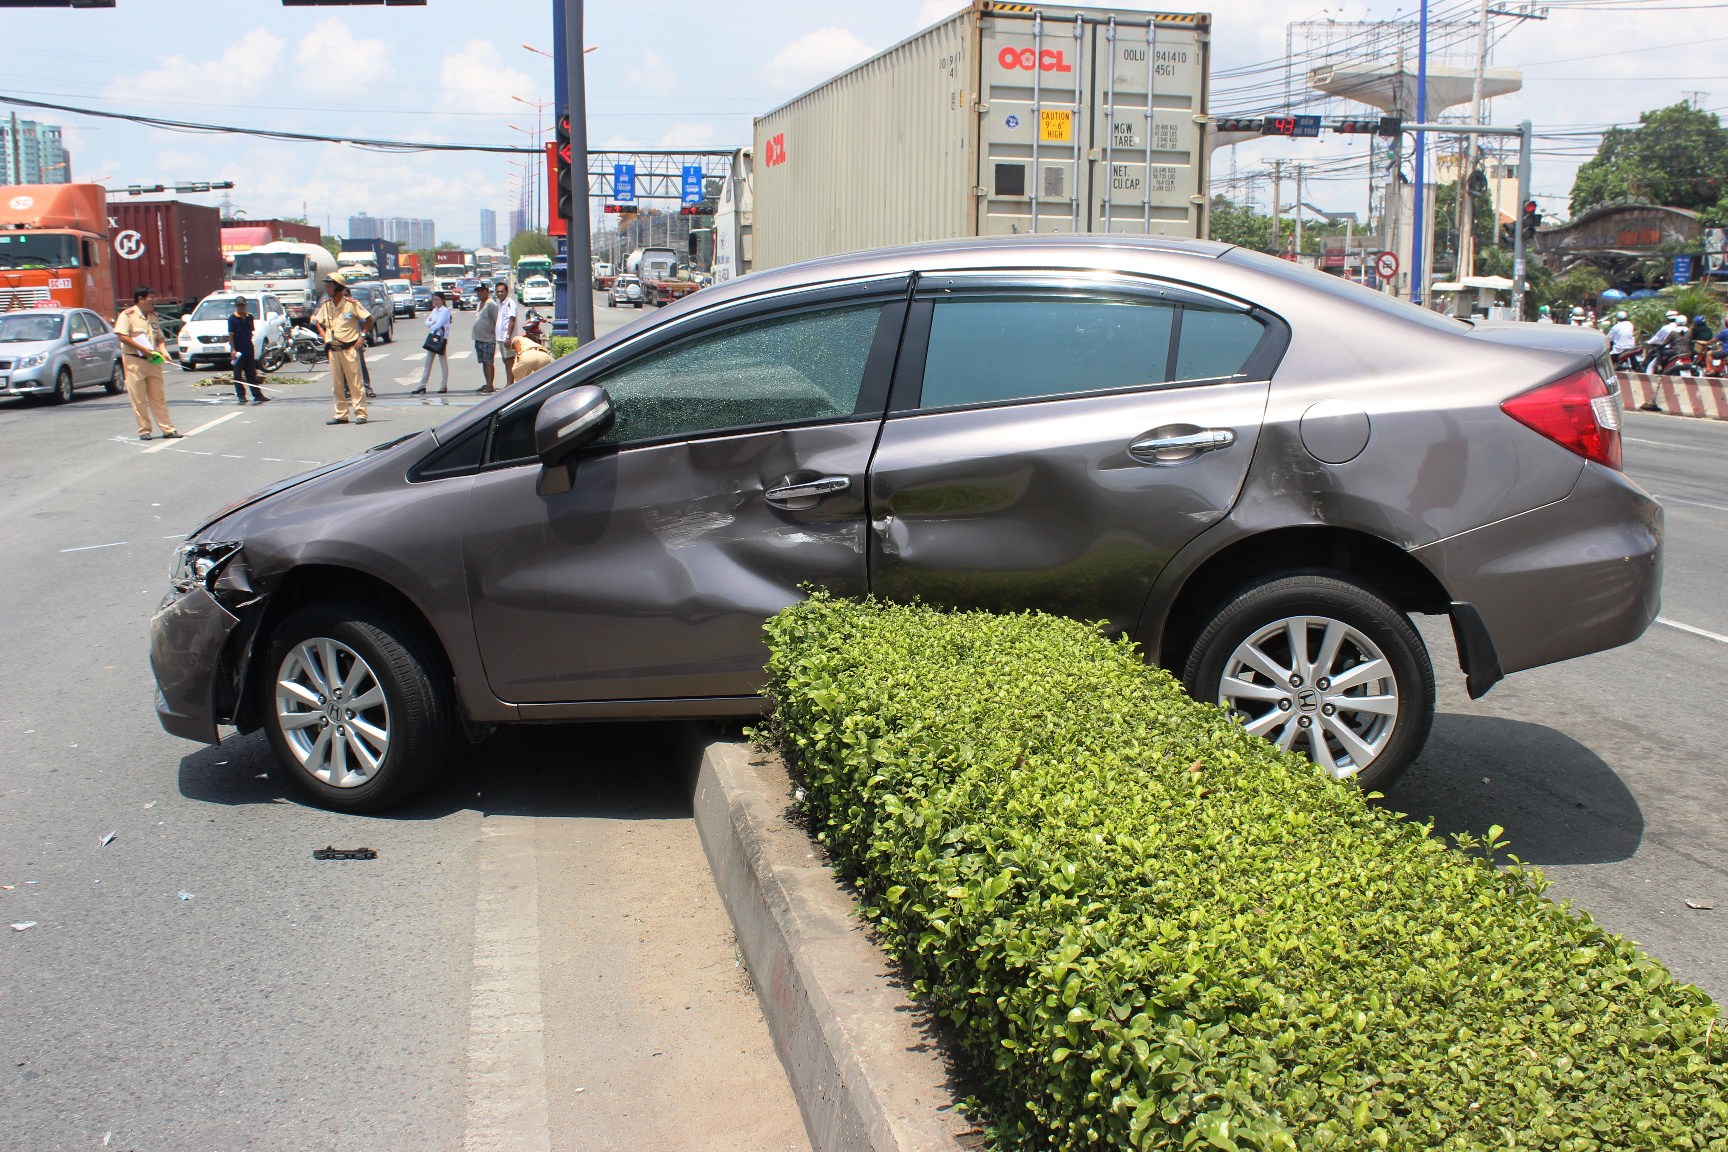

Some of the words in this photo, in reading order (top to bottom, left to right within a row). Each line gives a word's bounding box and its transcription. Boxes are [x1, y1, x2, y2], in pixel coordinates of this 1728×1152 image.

[998, 47, 1071, 72] OOCL
[1155, 51, 1187, 63] 941410
[1155, 64, 1175, 76] 45G1
[1041, 111, 1070, 121] CAUTION
[1114, 123, 1135, 134] MGW.
[1275, 118, 1295, 134] 43
[1047, 130, 1063, 139] HIGH
[1113, 166, 1129, 177] NET.
